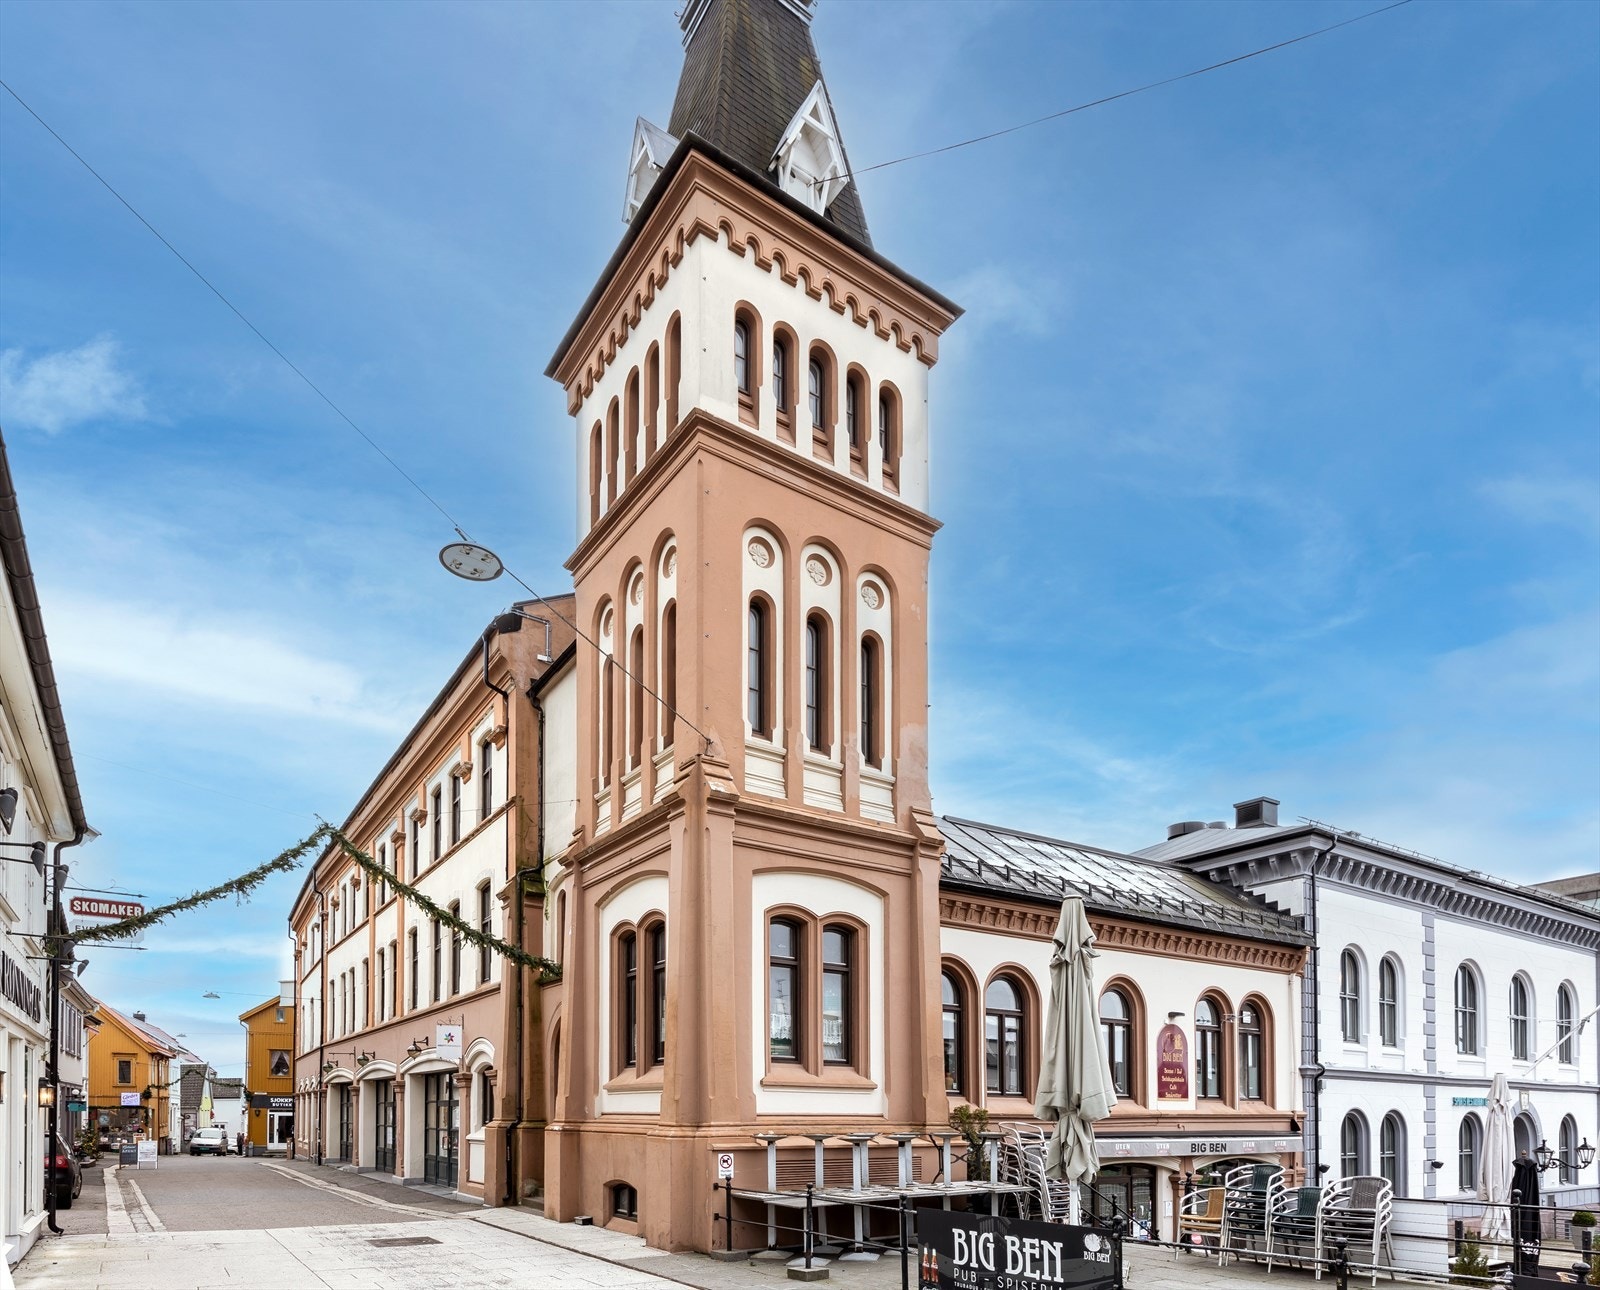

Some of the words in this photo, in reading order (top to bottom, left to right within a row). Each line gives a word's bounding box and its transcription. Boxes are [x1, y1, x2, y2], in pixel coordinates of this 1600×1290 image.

[73, 900, 142, 917] SKOMAKER
[1190, 1143, 1207, 1153] BIG
[1209, 1142, 1227, 1153] BEN
[951, 1227, 996, 1272] BIG
[1005, 1235, 1064, 1283] BEN
[1083, 1250, 1095, 1261] BIG
[1096, 1252, 1110, 1263] BEN
[953, 1267, 977, 1283] PUB
